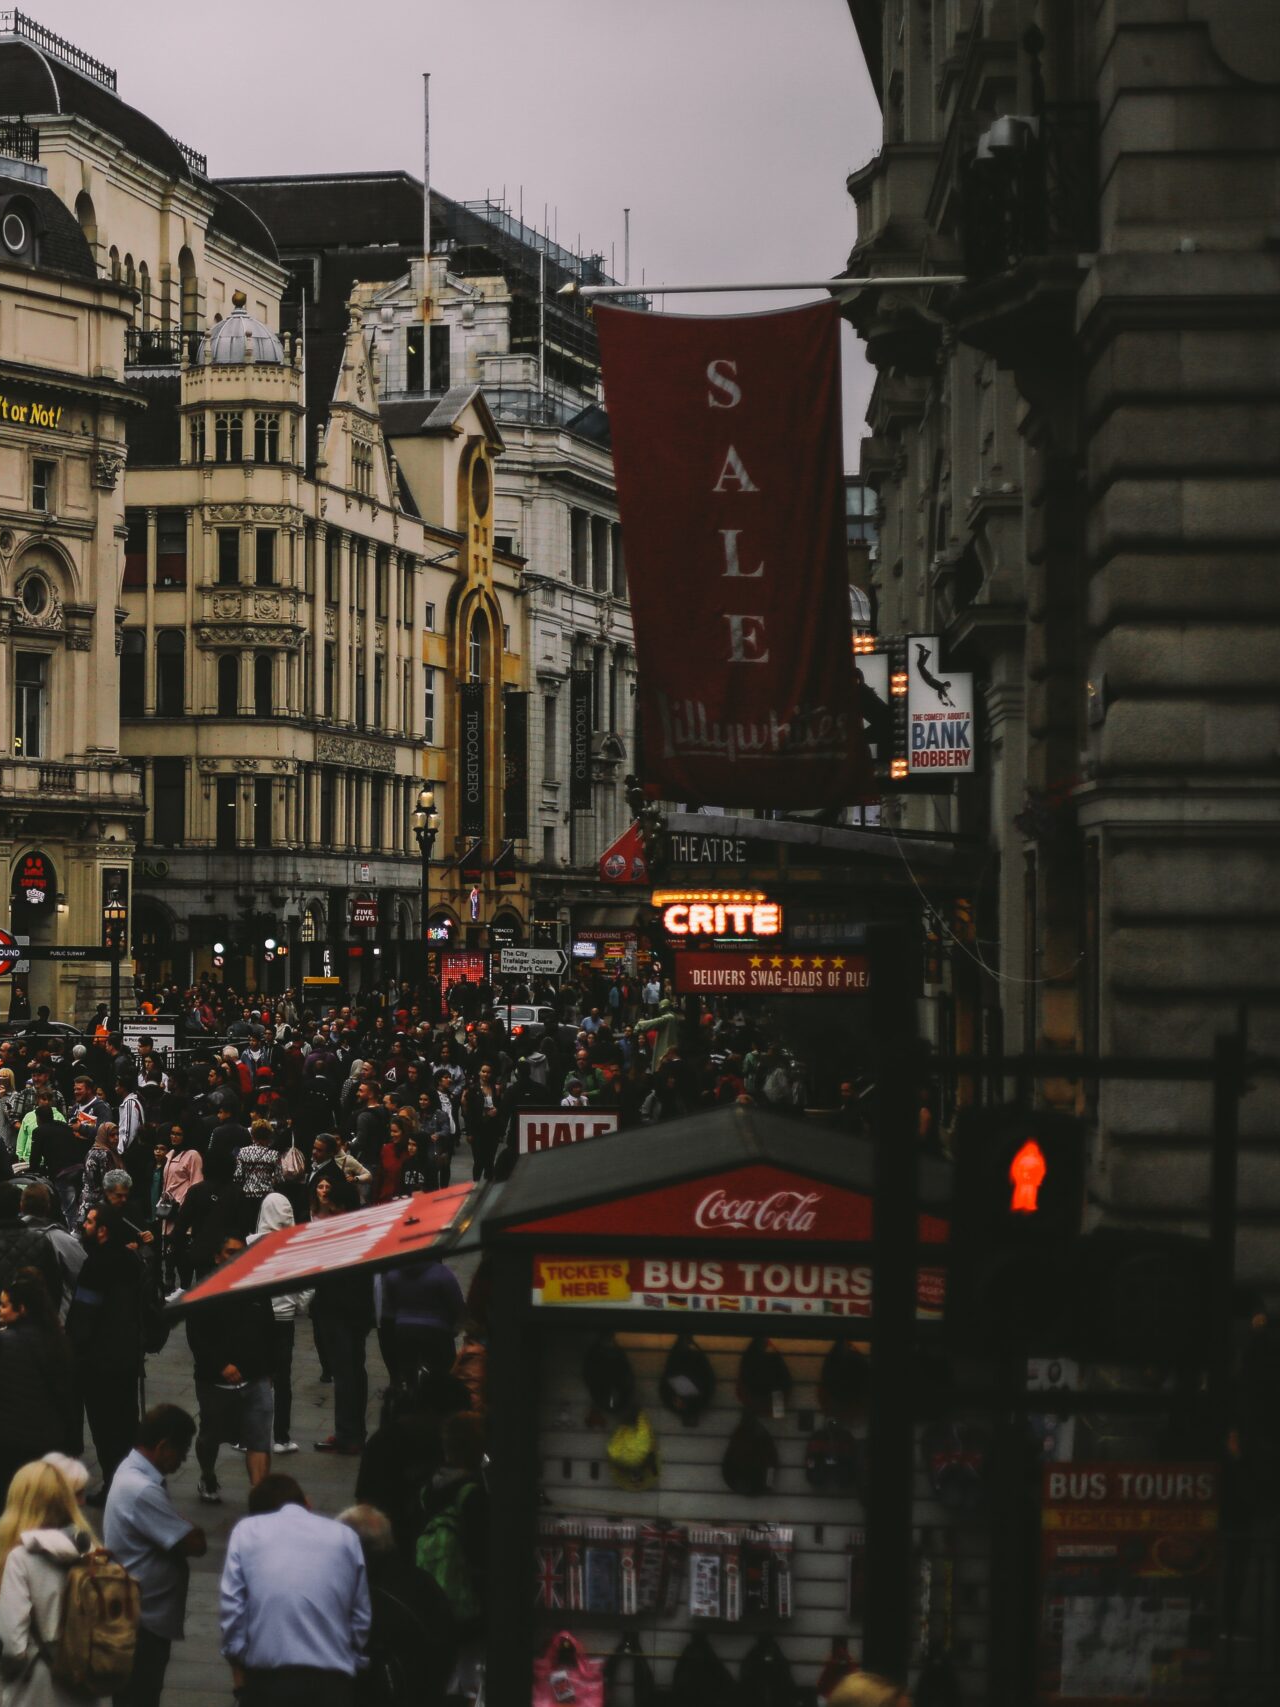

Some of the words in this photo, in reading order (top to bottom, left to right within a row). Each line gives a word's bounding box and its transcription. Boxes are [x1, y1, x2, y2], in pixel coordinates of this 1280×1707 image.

[11, 404, 28, 422] or
[29, 402, 62, 429] Not!
[706, 359, 769, 663] SALE
[912, 713, 923, 721] THE
[924, 713, 946, 721] COMEDY
[947, 712, 965, 720] ABOUT
[576, 696, 587, 779] TROCADERO
[912, 721, 970, 749] BANK
[467, 711, 479, 803] TROCADERO
[912, 750, 971, 767] ROBBERY
[671, 836, 747, 863] THEATRE
[502, 965, 517, 973] Hyde
[503, 957, 529, 965] Trafalgar
[532, 958, 553, 966] Square
[751, 970, 822, 987] SWAG-LOADS
[828, 971, 840, 987] OF
[694, 1189, 822, 1231] Coca-Cola
[546, 1264, 624, 1281] TICKETS
[643, 1260, 723, 1291] BUS
[738, 1263, 872, 1296] TOURS
[560, 1281, 609, 1297] HERE
[1049, 1472, 1107, 1500] BUS
[1118, 1472, 1214, 1500] TOURS
